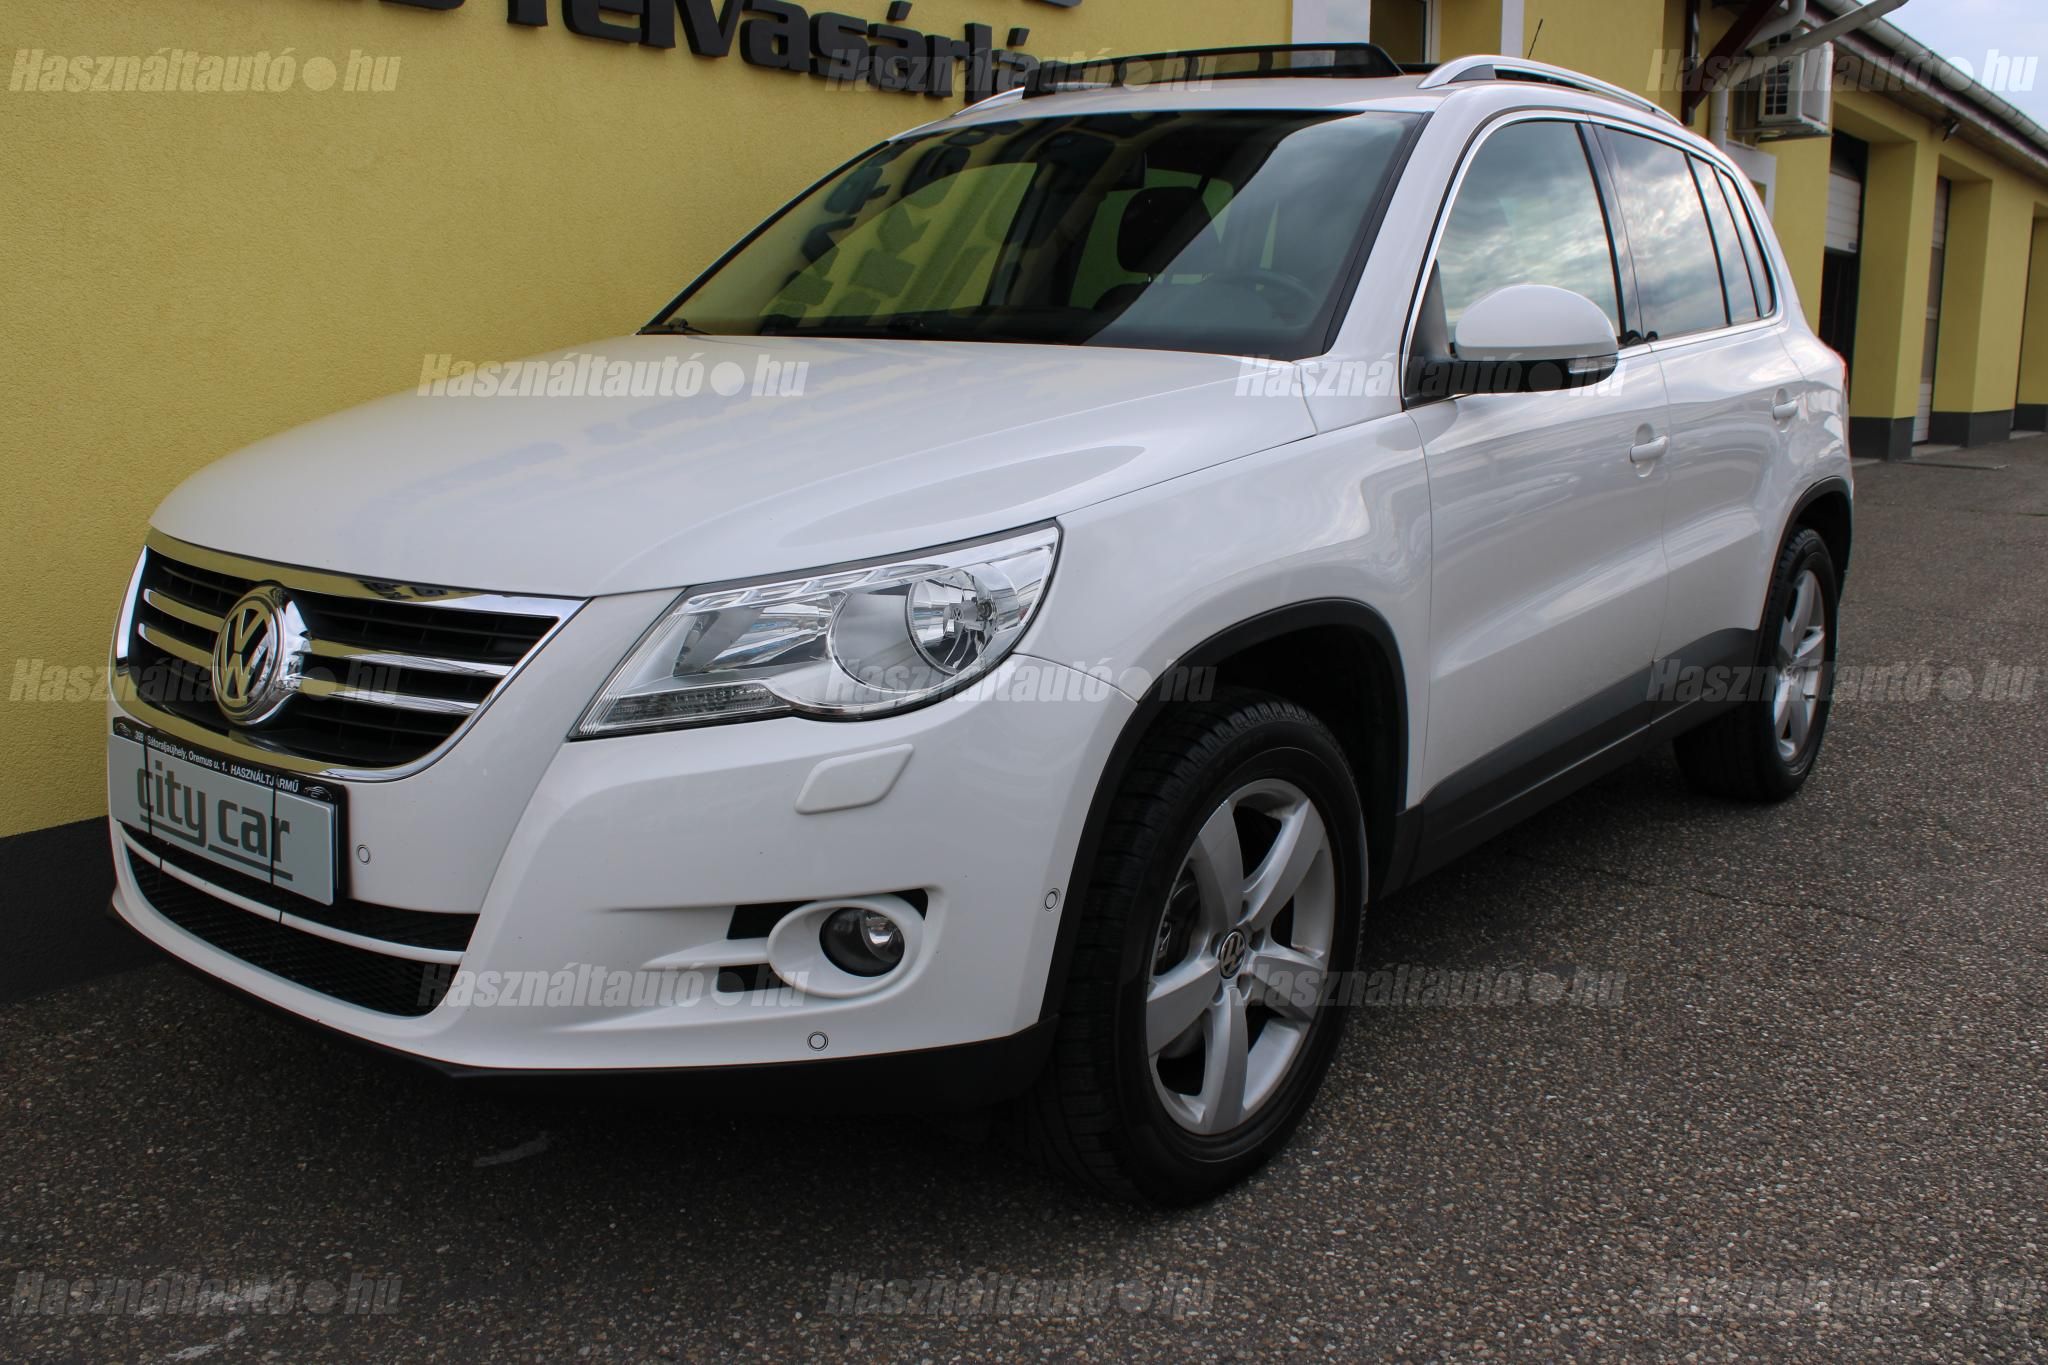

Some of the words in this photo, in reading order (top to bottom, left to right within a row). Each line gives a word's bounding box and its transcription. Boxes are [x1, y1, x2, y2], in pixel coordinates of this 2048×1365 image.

[188, 750, 213, 767] Oremus
[136, 759, 206, 848] city
[217, 799, 290, 863] car
